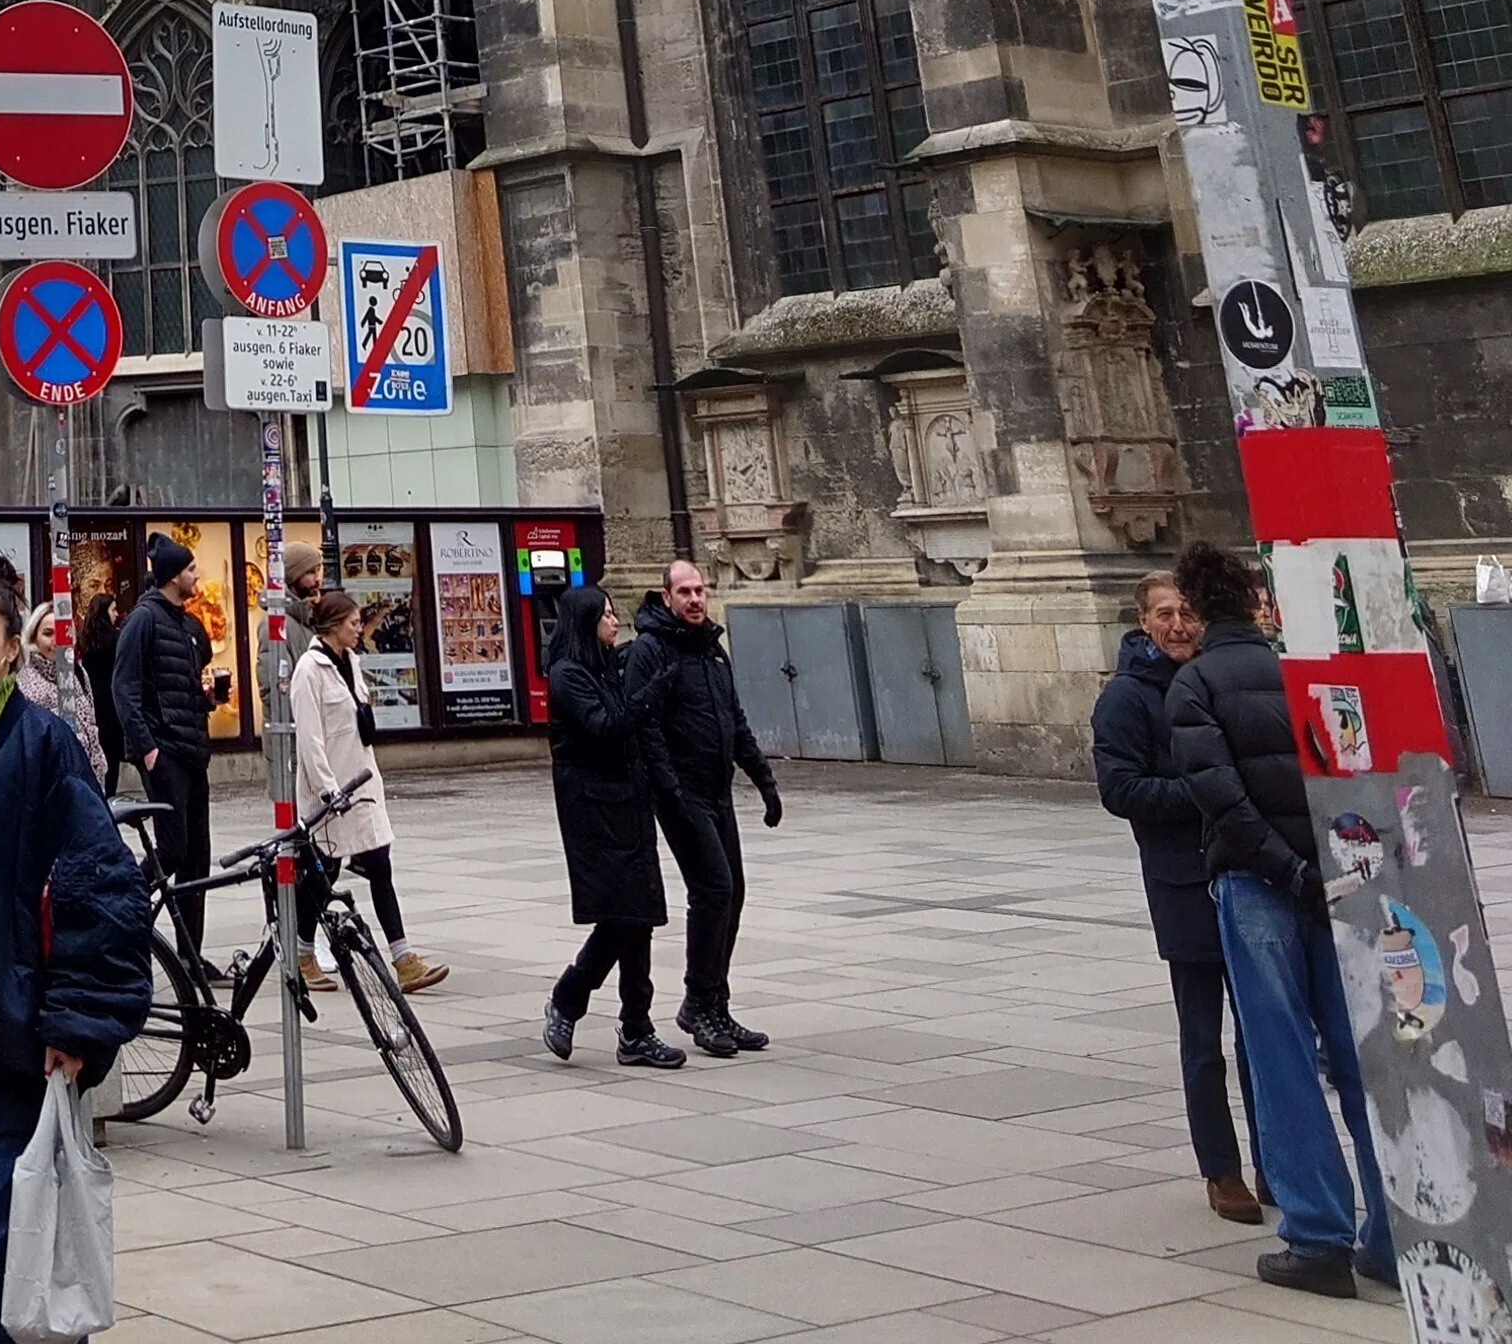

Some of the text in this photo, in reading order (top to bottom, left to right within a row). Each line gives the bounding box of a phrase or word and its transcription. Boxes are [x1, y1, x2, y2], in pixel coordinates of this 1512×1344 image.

[218, 10, 313, 40] Aufstellordnung
[66, 210, 129, 235] Fiaker
[245, 292, 306, 316] ANFANG
[233, 342, 322, 357] ausgen. 6 Fiaker
[400, 326, 428, 357] 20
[262, 357, 295, 370] sowie
[39, 380, 86, 402] ENDE
[91, 528, 128, 541] mozart
[440, 547, 493, 559] ROBERTINO
